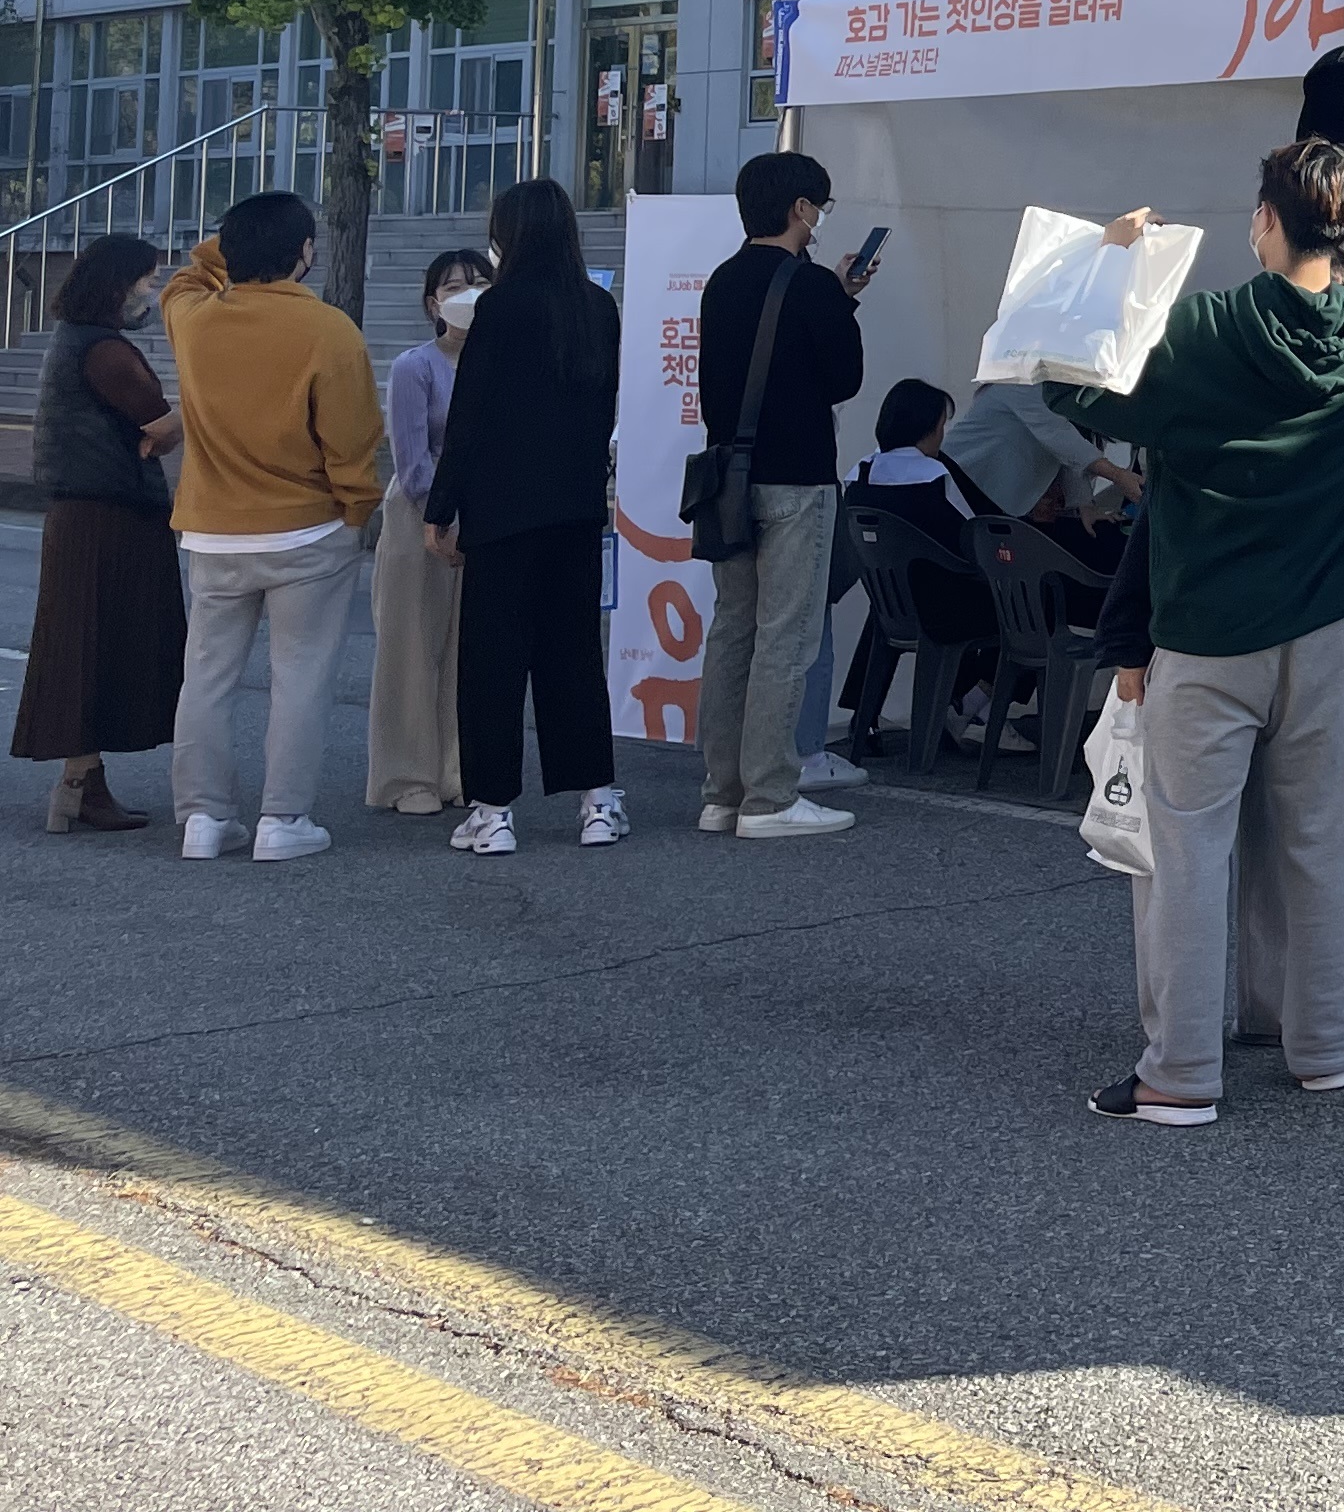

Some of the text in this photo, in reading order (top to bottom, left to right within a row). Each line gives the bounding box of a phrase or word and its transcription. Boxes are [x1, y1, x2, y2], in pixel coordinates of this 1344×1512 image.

[844, 3, 891, 43] 호감
[896, 0, 940, 38] 가는
[834, 48, 939, 79] 퍼스널컬러 진단
